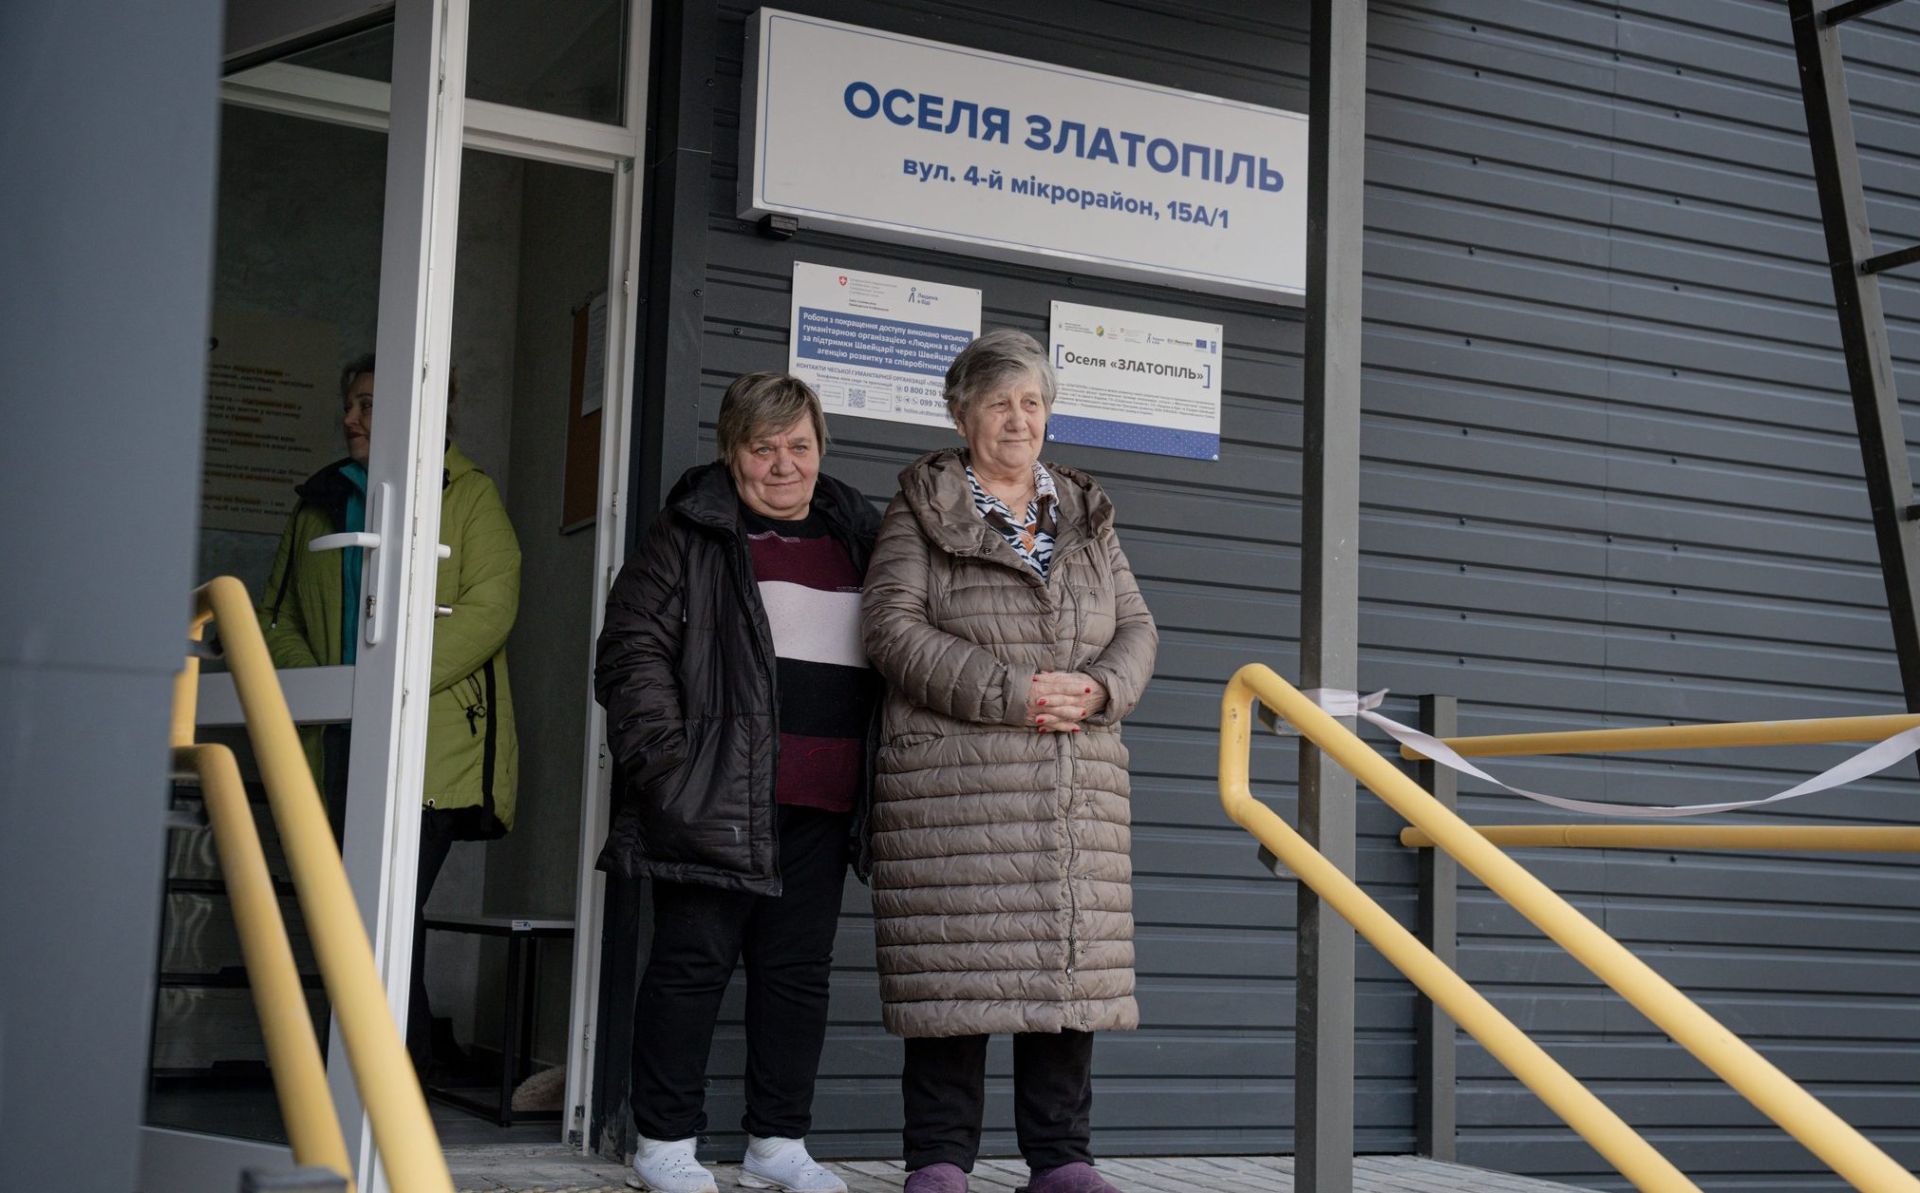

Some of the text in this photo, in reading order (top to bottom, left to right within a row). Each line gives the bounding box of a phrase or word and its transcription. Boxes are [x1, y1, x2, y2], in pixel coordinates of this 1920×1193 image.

[843, 81, 1285, 193] ОСЕЛЯ ЗЛАТОПІЛЬ
[902, 158, 1230, 229] вул. 4-й мікрорайон, 15А/1
[803, 312, 828, 322] Роботи
[834, 318, 878, 329] покращення
[879, 324, 906, 335] доступу
[907, 328, 940, 339] виконано
[940, 333, 969, 343] чеською
[803, 325, 857, 338] гуманітарною
[857, 332, 907, 345] організацією
[908, 338, 943, 349] «Людина
[812, 337, 853, 348] підтримки
[854, 341, 894, 354] Швейцарії
[895, 348, 917, 358] через
[817, 348, 848, 359] агенцію
[849, 352, 883, 364] розвитку
[1064, 351, 1204, 380] Оселя «ЗЛАТОПІЛЬ»
[910, 387, 924, 395] 800
[925, 389, 938, 397] 210
